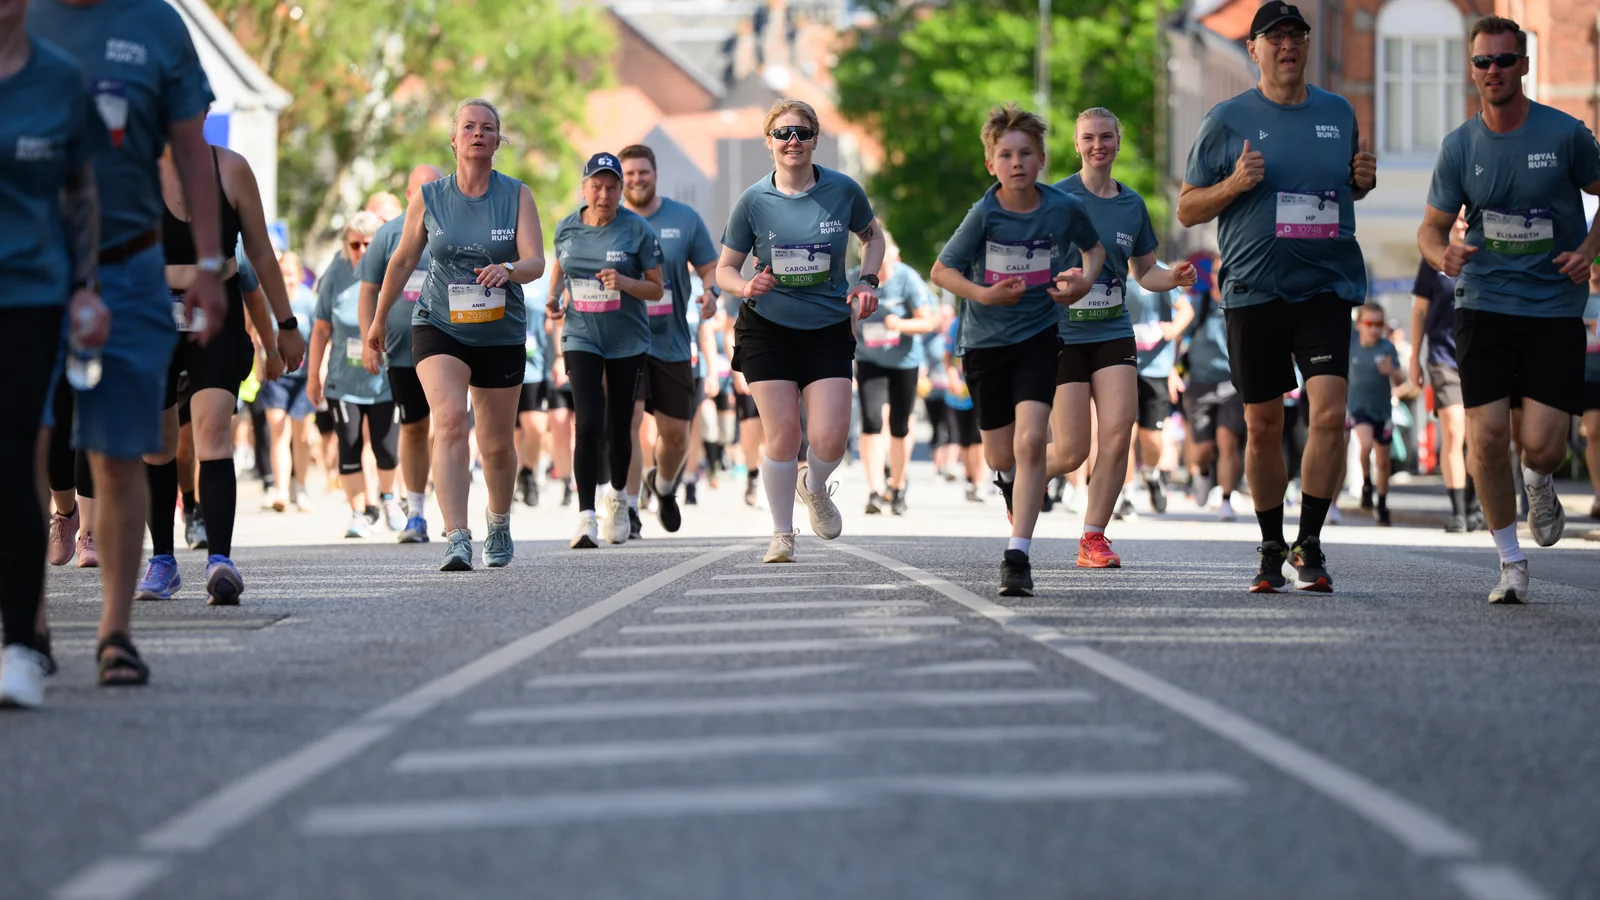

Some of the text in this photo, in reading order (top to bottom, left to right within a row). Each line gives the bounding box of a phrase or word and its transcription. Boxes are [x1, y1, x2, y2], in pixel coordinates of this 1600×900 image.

[1528, 152, 1557, 161] ROYAL
[597, 157, 613, 167] 62
[820, 220, 842, 228] ROYAL
[1284, 225, 1322, 233] D 10748
[1116, 231, 1134, 241] ROYAL
[1496, 231, 1539, 239] ELISABETH
[1492, 241, 1500, 249] C
[792, 275, 813, 283] 14016
[992, 273, 999, 281] D
[467, 311, 492, 320] 20382
[1089, 309, 1109, 317] 14019
